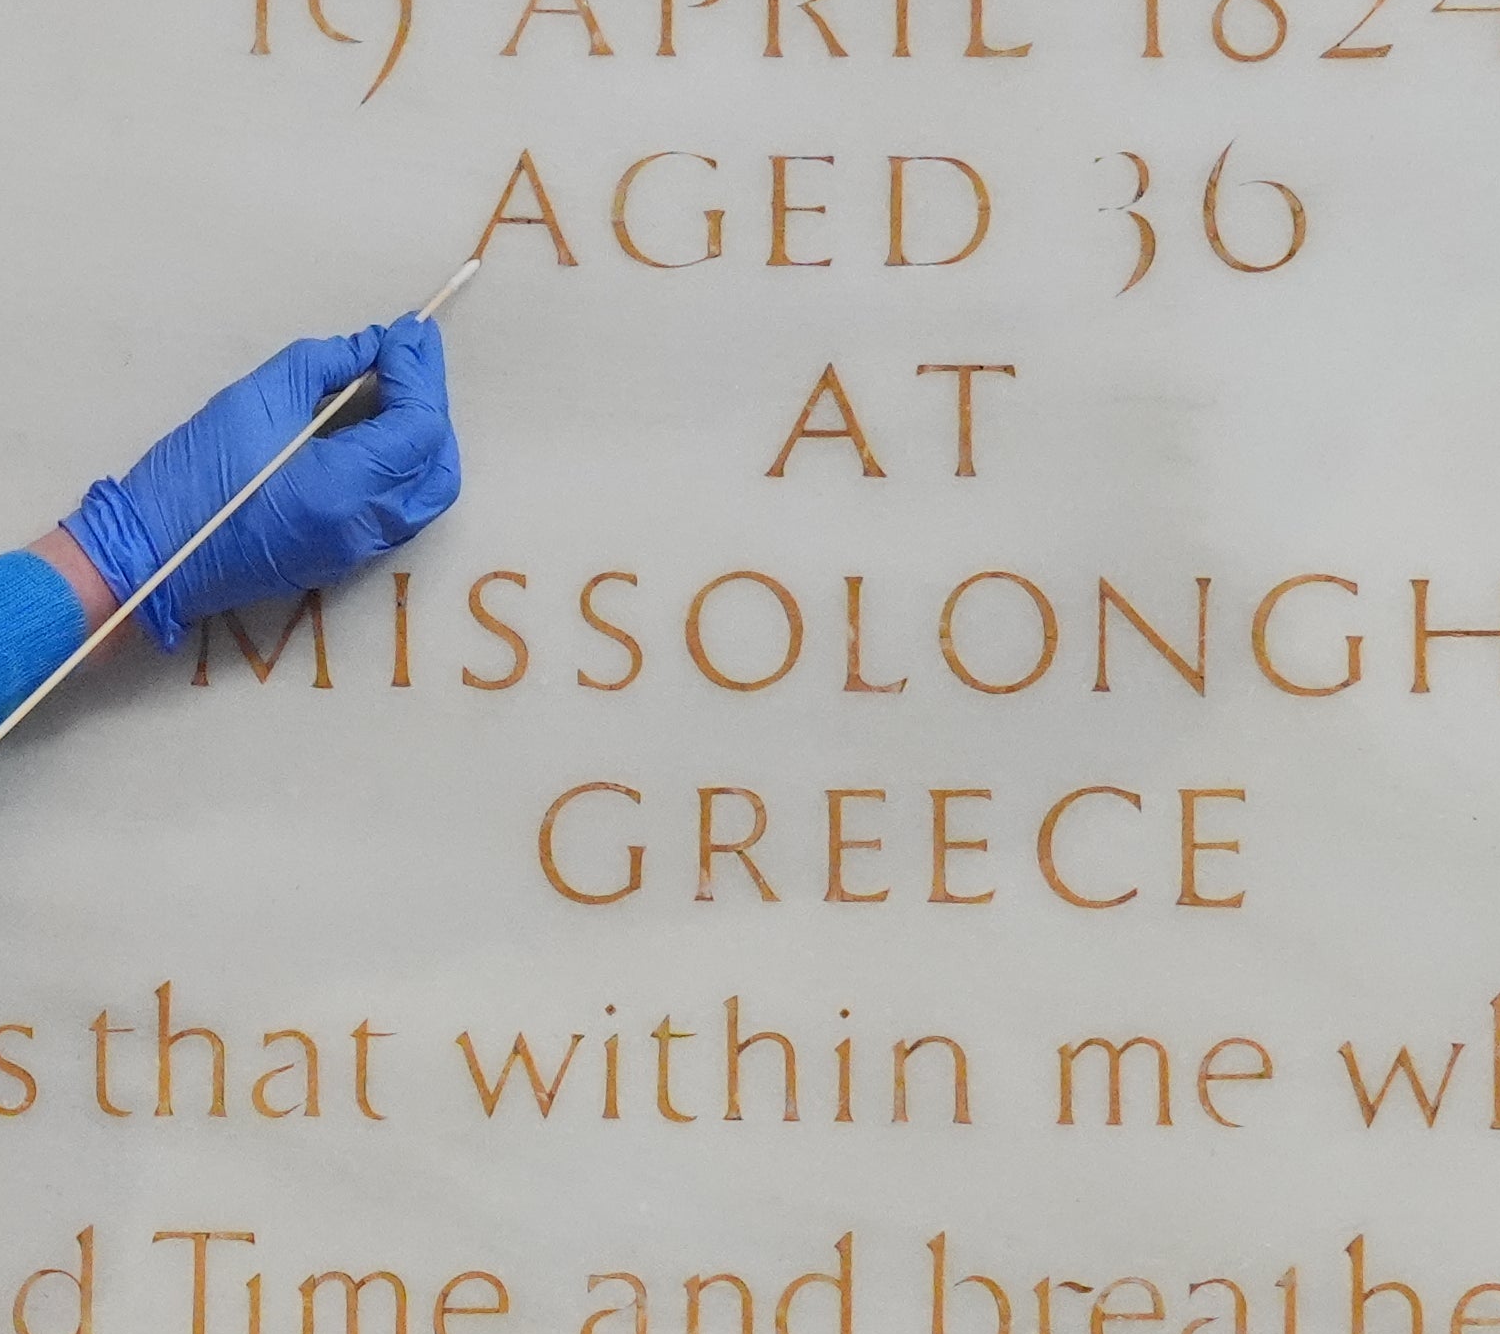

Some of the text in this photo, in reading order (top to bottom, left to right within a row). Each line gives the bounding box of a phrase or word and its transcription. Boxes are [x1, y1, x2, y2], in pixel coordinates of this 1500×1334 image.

[470, 141, 1309, 295] AGED 36
[766, 362, 1018, 479] AT
[536, 779, 1248, 912] GREECE
[88, 980, 398, 1124] that
[453, 995, 974, 1125] within
[1055, 1035, 1276, 1130] me
